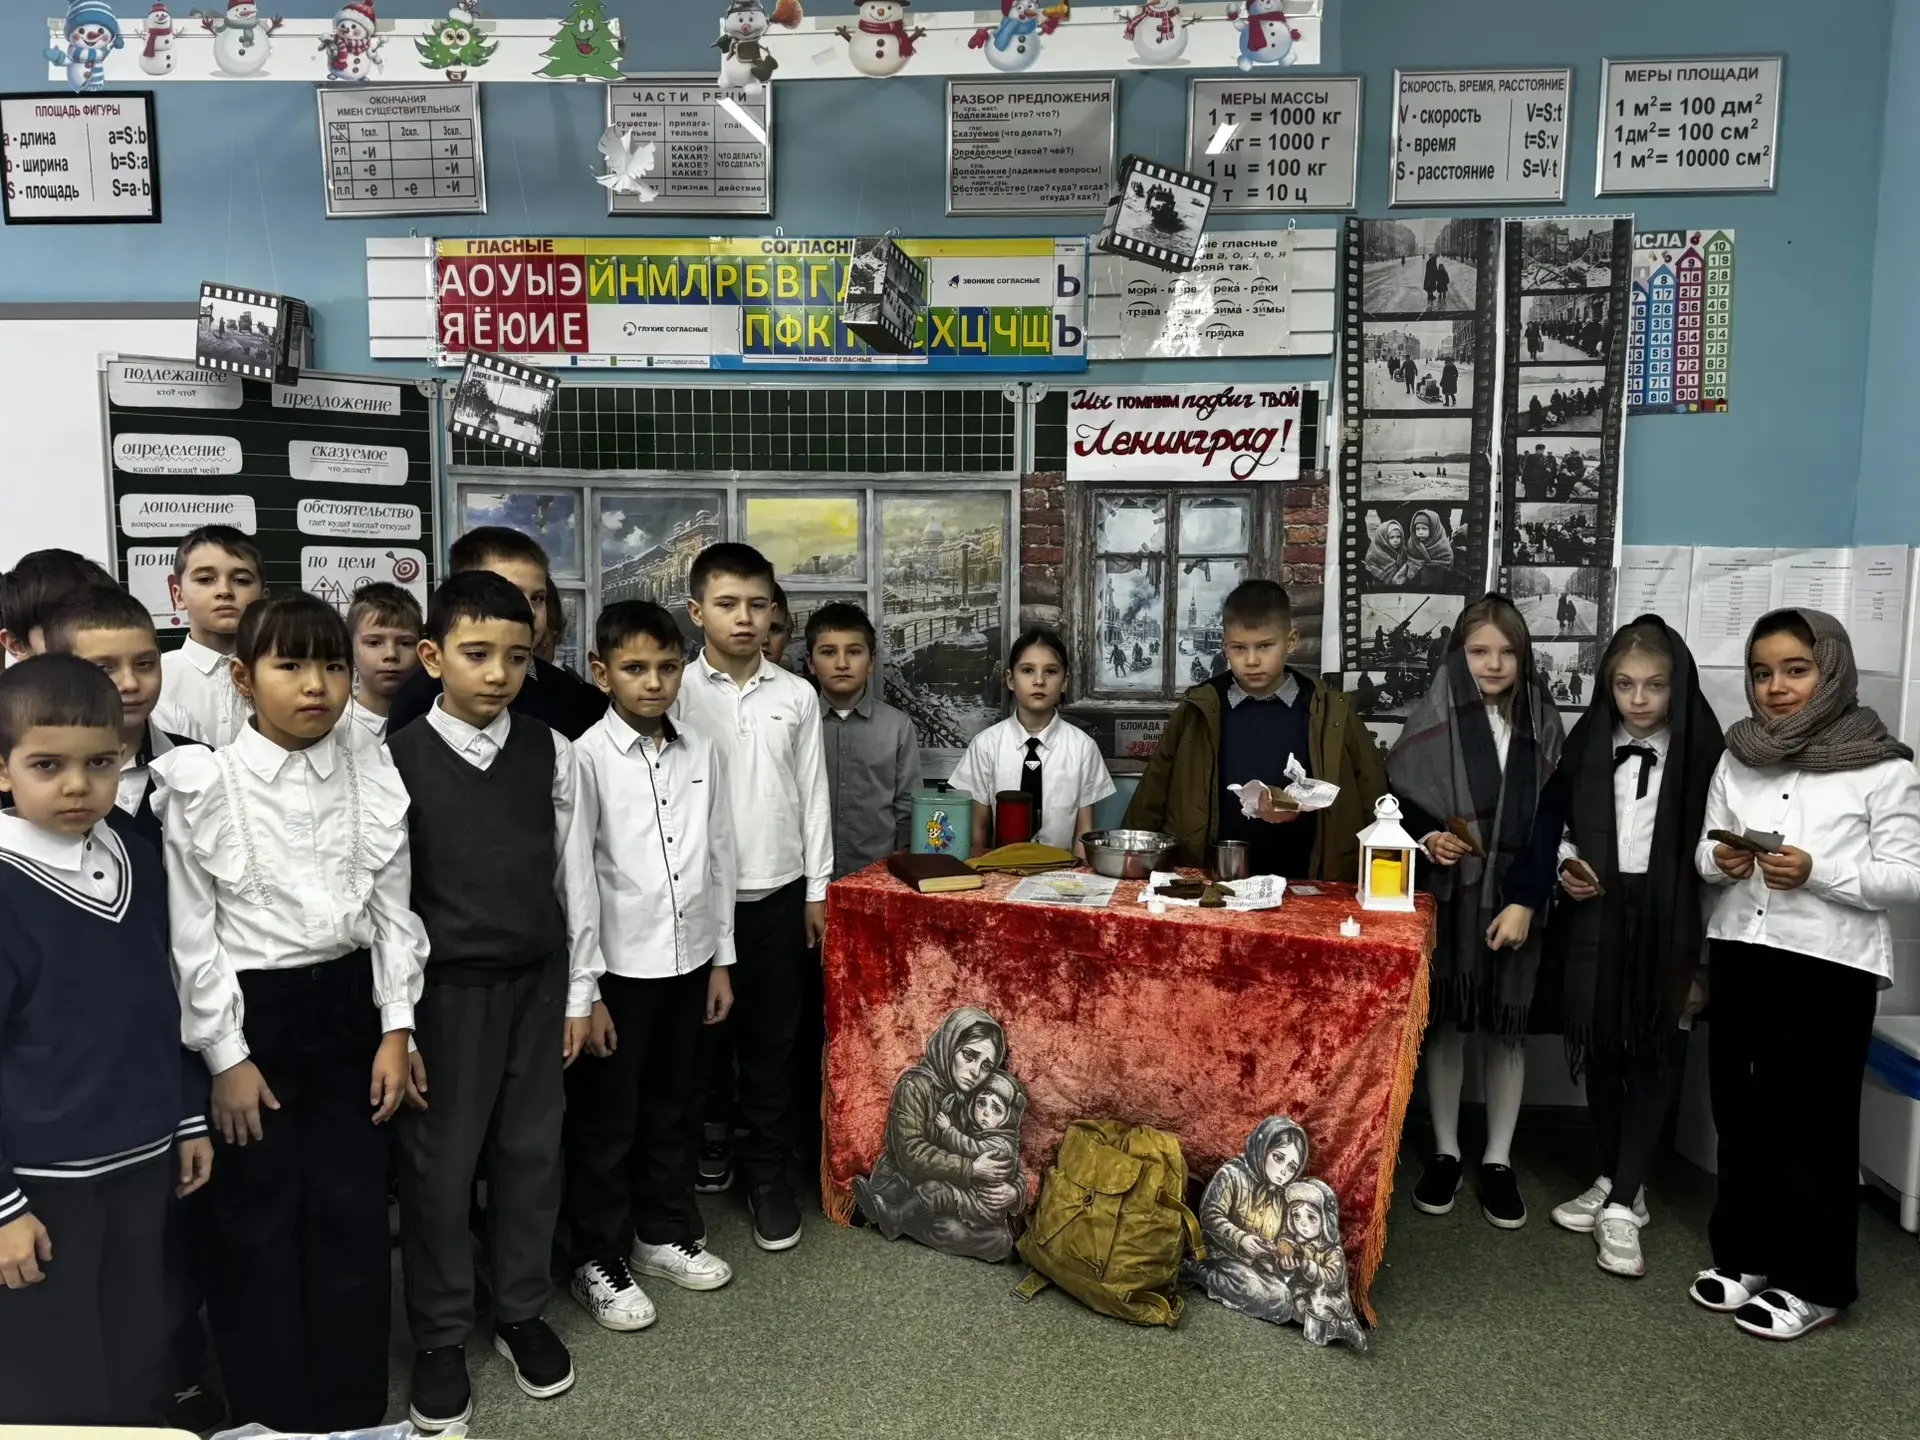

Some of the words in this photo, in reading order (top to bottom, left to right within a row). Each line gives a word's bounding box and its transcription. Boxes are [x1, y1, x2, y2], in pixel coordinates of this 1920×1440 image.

[1624, 70, 1672, 83] МЕРЫ
[1676, 67, 1759, 83] ПЛОЩАДИ
[1401, 81, 1456, 94] СКОРОСТЬ,
[1459, 80, 1496, 93] ВРЕМЯ,
[1499, 78, 1565, 92] РАССТОЯНИЕ
[369, 95, 426, 105] ОКОНЧАНИЯ
[632, 92, 689, 102] ЧАСТИ
[953, 94, 1004, 105] РАЗБОР
[1008, 92, 1110, 105] ПРЕДЛОЖЕНИЯ
[1221, 93, 1266, 105] МЕРЫ
[1271, 92, 1328, 105] МАССЫ
[35, 105, 81, 118] ПЛОЩАДЬ
[83, 104, 120, 116] ФИГУРЫ
[337, 107, 363, 116] ИМЕН
[365, 105, 461, 116] СУЩЕСТВИТЕЛЬНЫХ
[1615, 99, 1625, 117] 1
[1680, 97, 1715, 115] 100
[952, 111, 1009, 120] Подлежащее
[1010, 111, 1034, 119] (кто?
[1036, 110, 1060, 118] что?)
[1209, 109, 1217, 125] 1
[1269, 108, 1316, 125] 1000
[1322, 111, 1342, 125] кг
[1400, 105, 1408, 123] V
[1420, 107, 1481, 128] скорость
[952, 130, 1000, 139] Сказуемое
[1001, 130, 1020, 138] (что
[1021, 129, 1062, 138] делать?)
[1678, 123, 1714, 141] 100
[19, 131, 56, 149] длина
[1268, 133, 1314, 150] 1000
[1321, 137, 1330, 150] г
[1414, 137, 1456, 156] время
[671, 144, 708, 152] КАКОЙ?
[952, 148, 1013, 157] Определение
[1014, 148, 1048, 156] (какой?
[1613, 151, 1622, 168] 1
[1675, 148, 1729, 168] 10000
[22, 157, 69, 176] ширина
[953, 168, 1007, 176] Дополнение
[1009, 167, 1057, 176] (падежные
[1059, 166, 1102, 175] вопросы)
[1207, 160, 1215, 177] 1
[1224, 164, 1236, 179] ц
[1267, 159, 1301, 176] 100
[1307, 163, 1327, 176] кг
[1417, 165, 1494, 184] расстояние
[25, 184, 80, 201] площадь
[671, 184, 709, 192] признак
[953, 185, 1025, 193] Обстоятельство
[1027, 184, 1050, 193] (где?
[1052, 184, 1078, 192] куда?
[1079, 183, 1109, 191] когда?
[1266, 184, 1288, 201] 10
[1295, 188, 1307, 203] ц
[1040, 193, 1076, 201] откуда?
[1077, 193, 1100, 201] как?)
[466, 239, 554, 254] ГЛАСНЫЕ
[1222, 239, 1278, 248] гласные
[1634, 233, 1682, 248] ИСЛА
[1714, 242, 1726, 251] 10
[1229, 263, 1252, 271] так.
[1688, 259, 1695, 267] 9
[997, 277, 1040, 285] СОГЛАСНЫЕ
[1661, 276, 1668, 285] 8
[124, 368, 228, 384] подлежащее
[282, 393, 392, 412] предложение
[1182, 386, 1255, 421] подвиг
[122, 443, 226, 457] определение
[312, 446, 387, 461] сказуемое
[1074, 419, 1293, 480] Ленинград!
[139, 501, 234, 515] дополнение
[304, 500, 413, 519] обстоятельство
[134, 554, 155, 566] по
[308, 556, 328, 568] по
[338, 556, 376, 571] цели
[1121, 722, 1160, 731] БЛОКАДА
